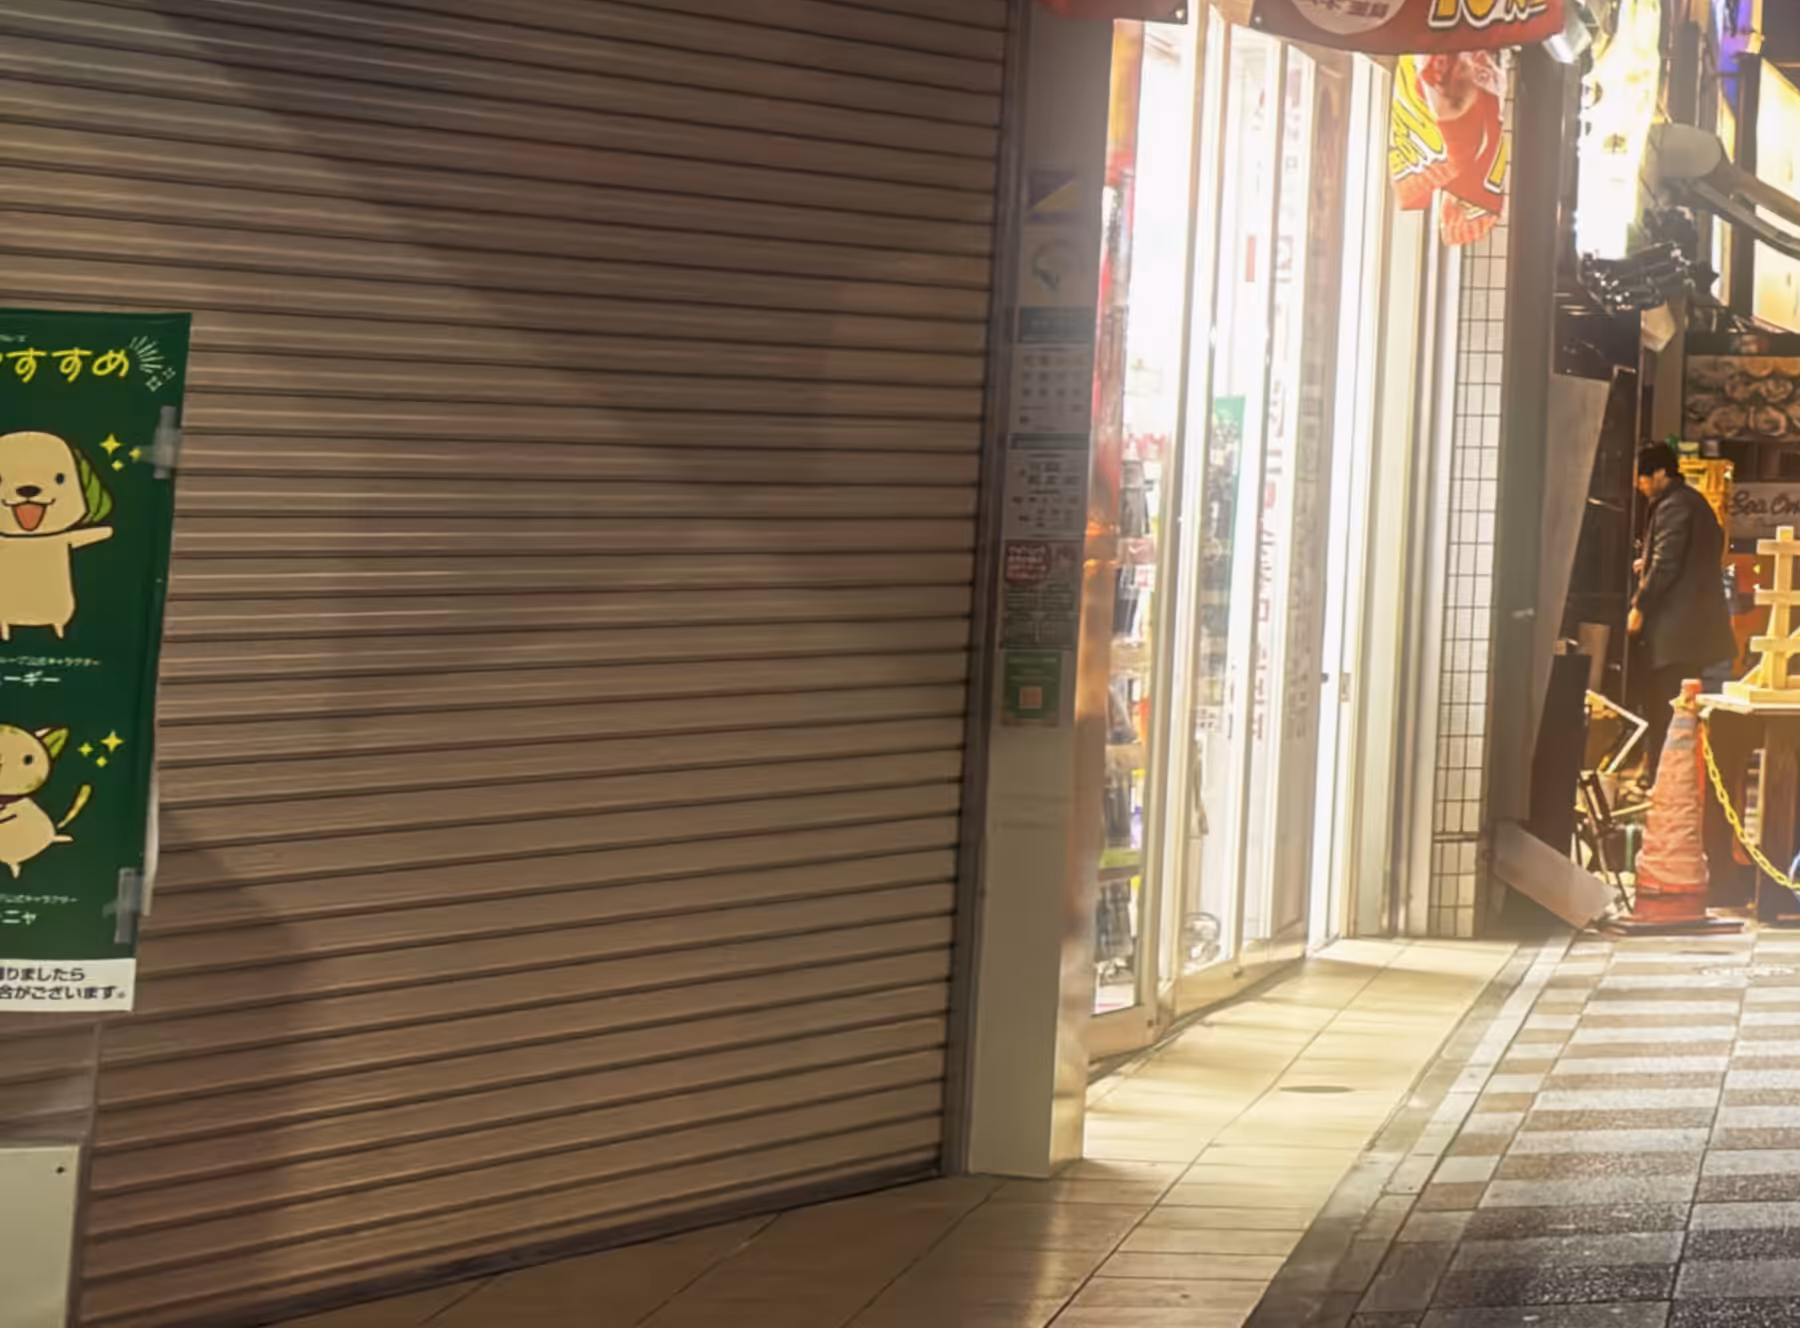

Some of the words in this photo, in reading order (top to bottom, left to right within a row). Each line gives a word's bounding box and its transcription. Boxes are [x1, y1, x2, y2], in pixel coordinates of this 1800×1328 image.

[0, 346, 130, 383] すすめ
[0, 966, 86, 982] りましたら
